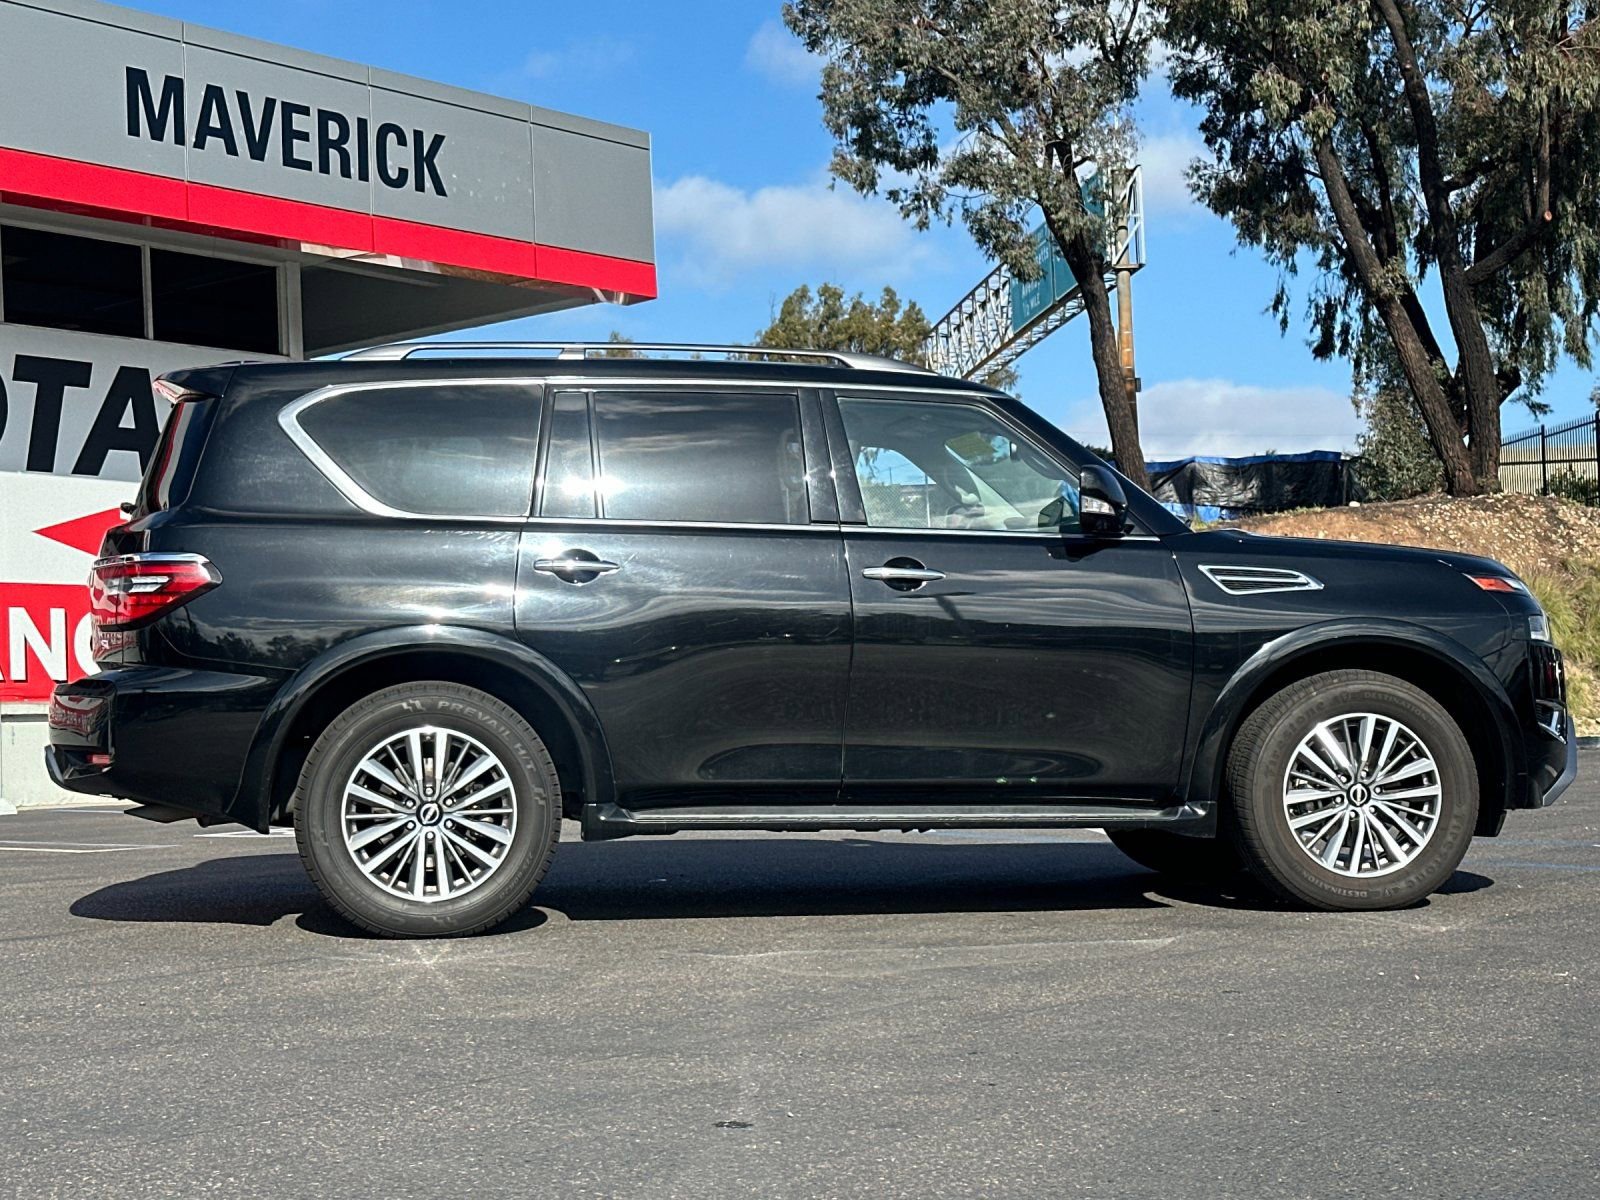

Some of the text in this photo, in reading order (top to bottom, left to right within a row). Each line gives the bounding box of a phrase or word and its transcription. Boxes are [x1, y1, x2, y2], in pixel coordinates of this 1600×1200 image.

[125, 65, 449, 198] MAVERICK
[0, 353, 161, 477] TA
[437, 699, 537, 772] PREVAIL H/T
[1302, 869, 1368, 898] DESTINATION
